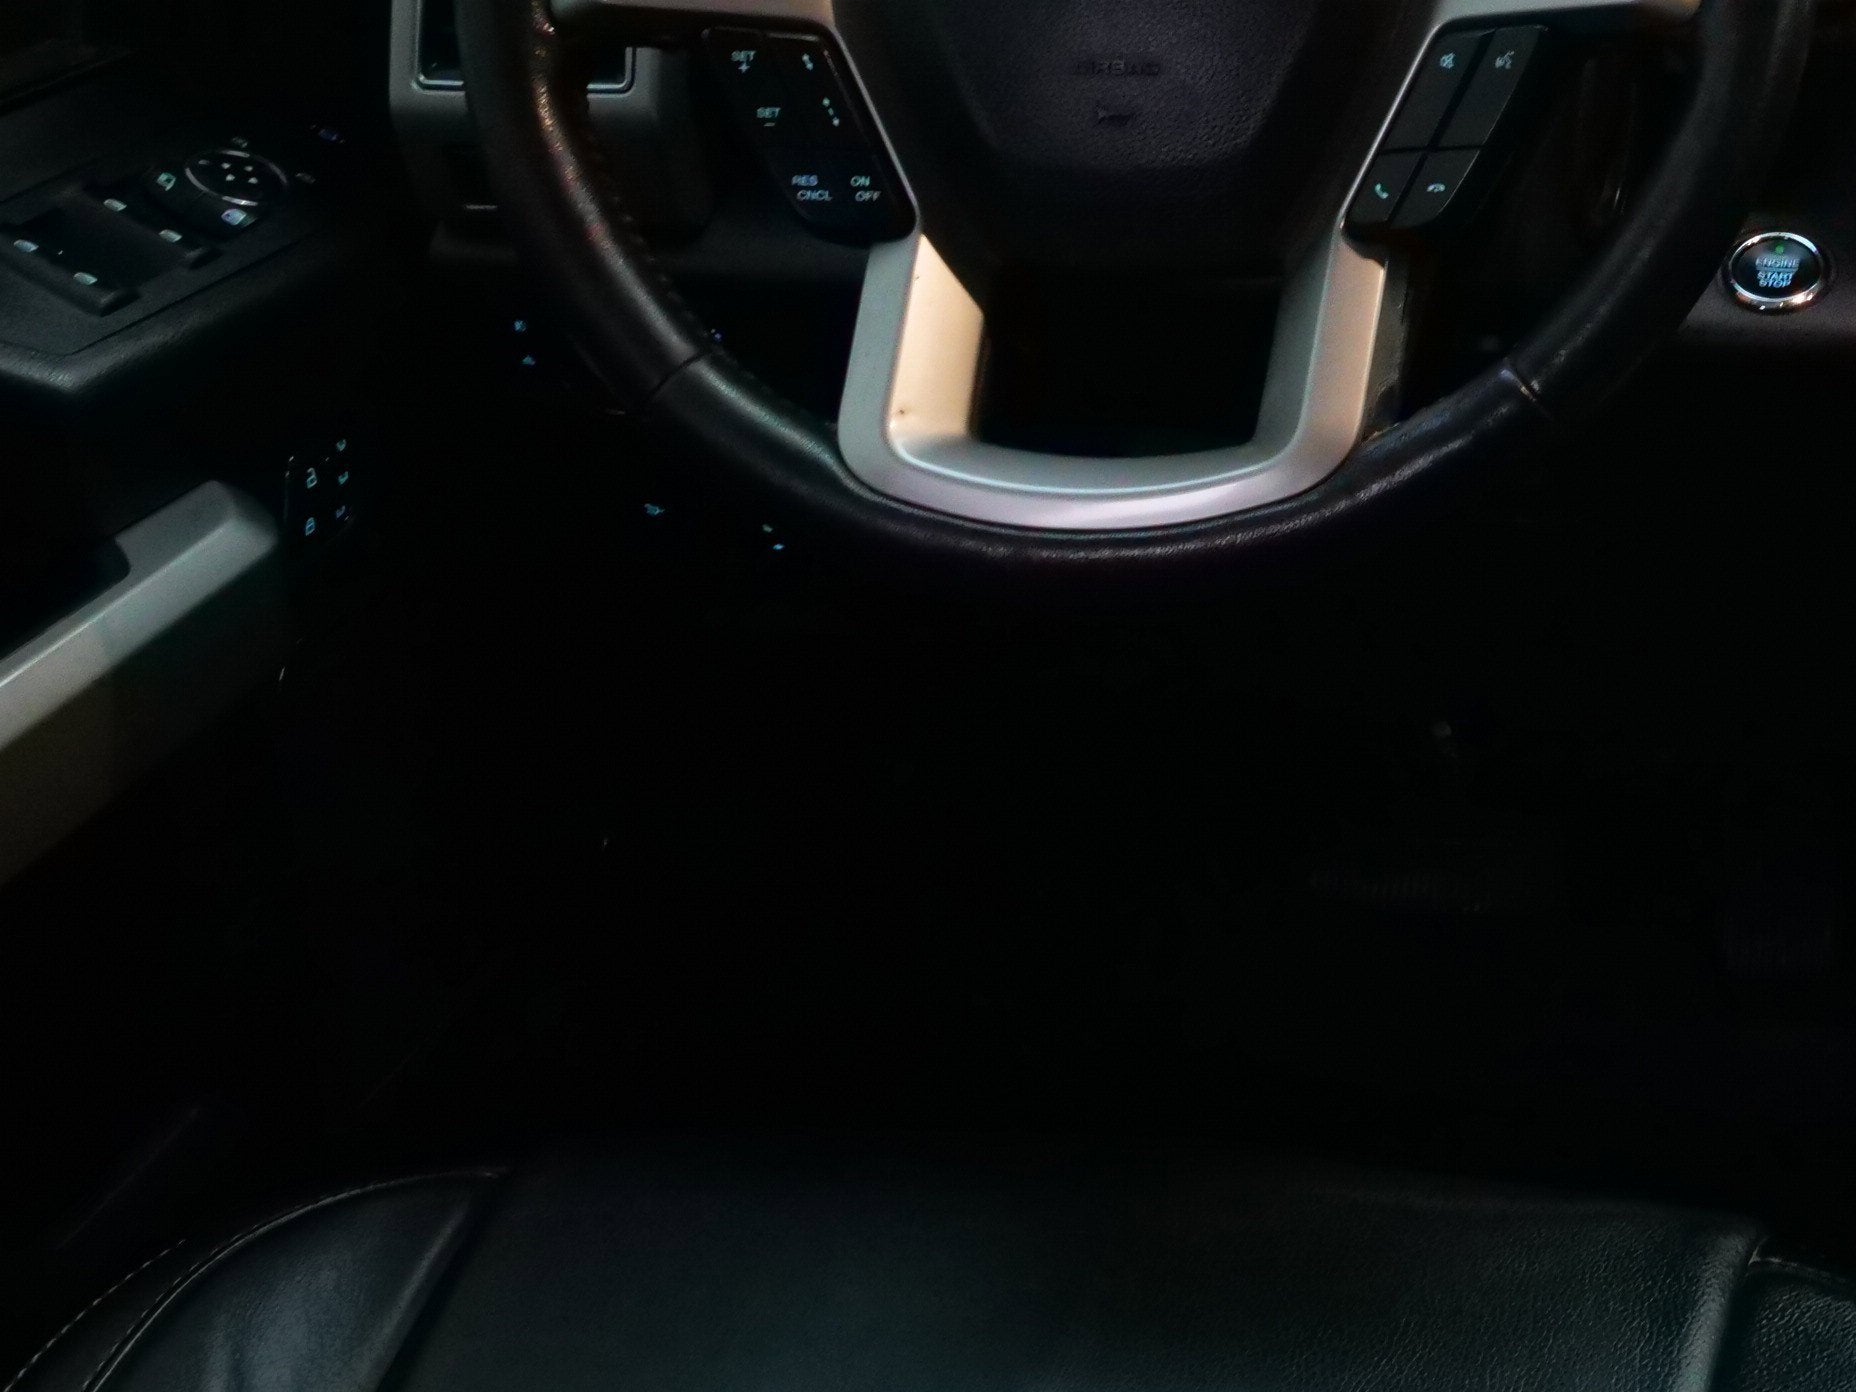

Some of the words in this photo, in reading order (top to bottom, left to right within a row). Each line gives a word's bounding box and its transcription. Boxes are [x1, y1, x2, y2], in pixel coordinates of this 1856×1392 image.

[757, 106, 781, 119] SET
[791, 174, 818, 187] RES
[850, 175, 871, 187] ON
[796, 189, 832, 201] CNCL
[854, 189, 881, 201] OFF
[1757, 270, 1794, 280] START
